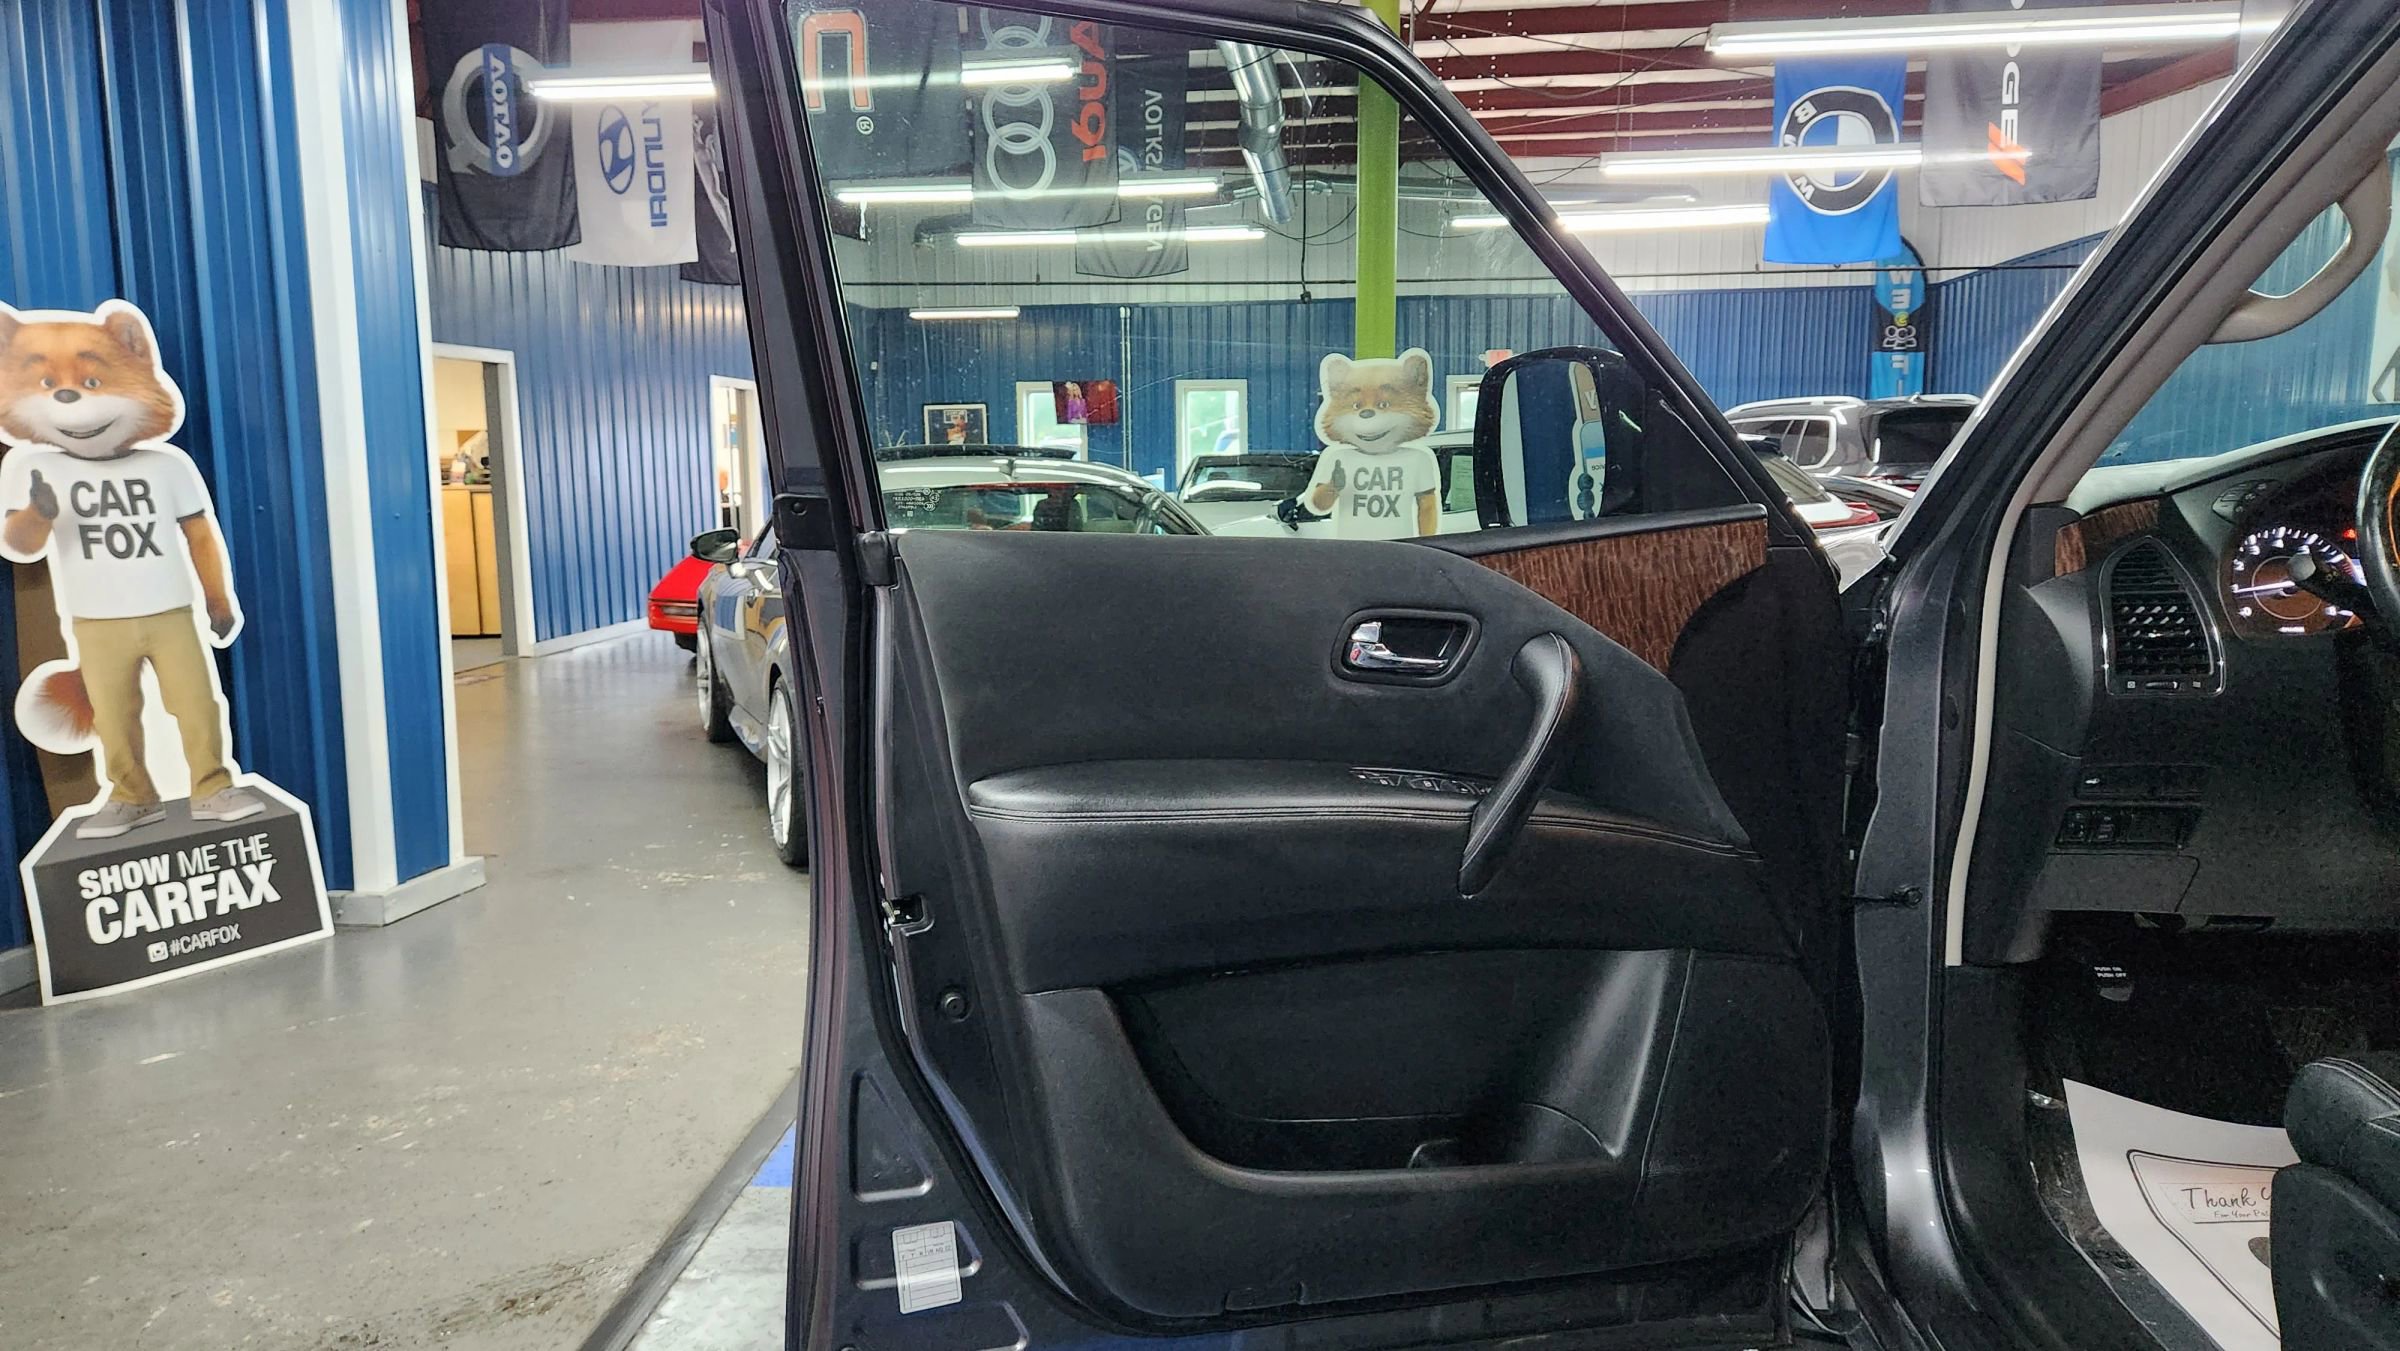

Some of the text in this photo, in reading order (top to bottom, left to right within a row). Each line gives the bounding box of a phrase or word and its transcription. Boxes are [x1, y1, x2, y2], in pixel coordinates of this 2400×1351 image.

[1353, 466, 1404, 491] CAR
[70, 479, 157, 518] CAR
[1352, 494, 1401, 518] FOX
[78, 521, 164, 560] FOX
[78, 833, 273, 900] SHOW ME THE
[85, 859, 282, 944] CARFAX
[170, 923, 242, 957] #CARFOX
[2180, 1187, 2257, 1209] Thank
